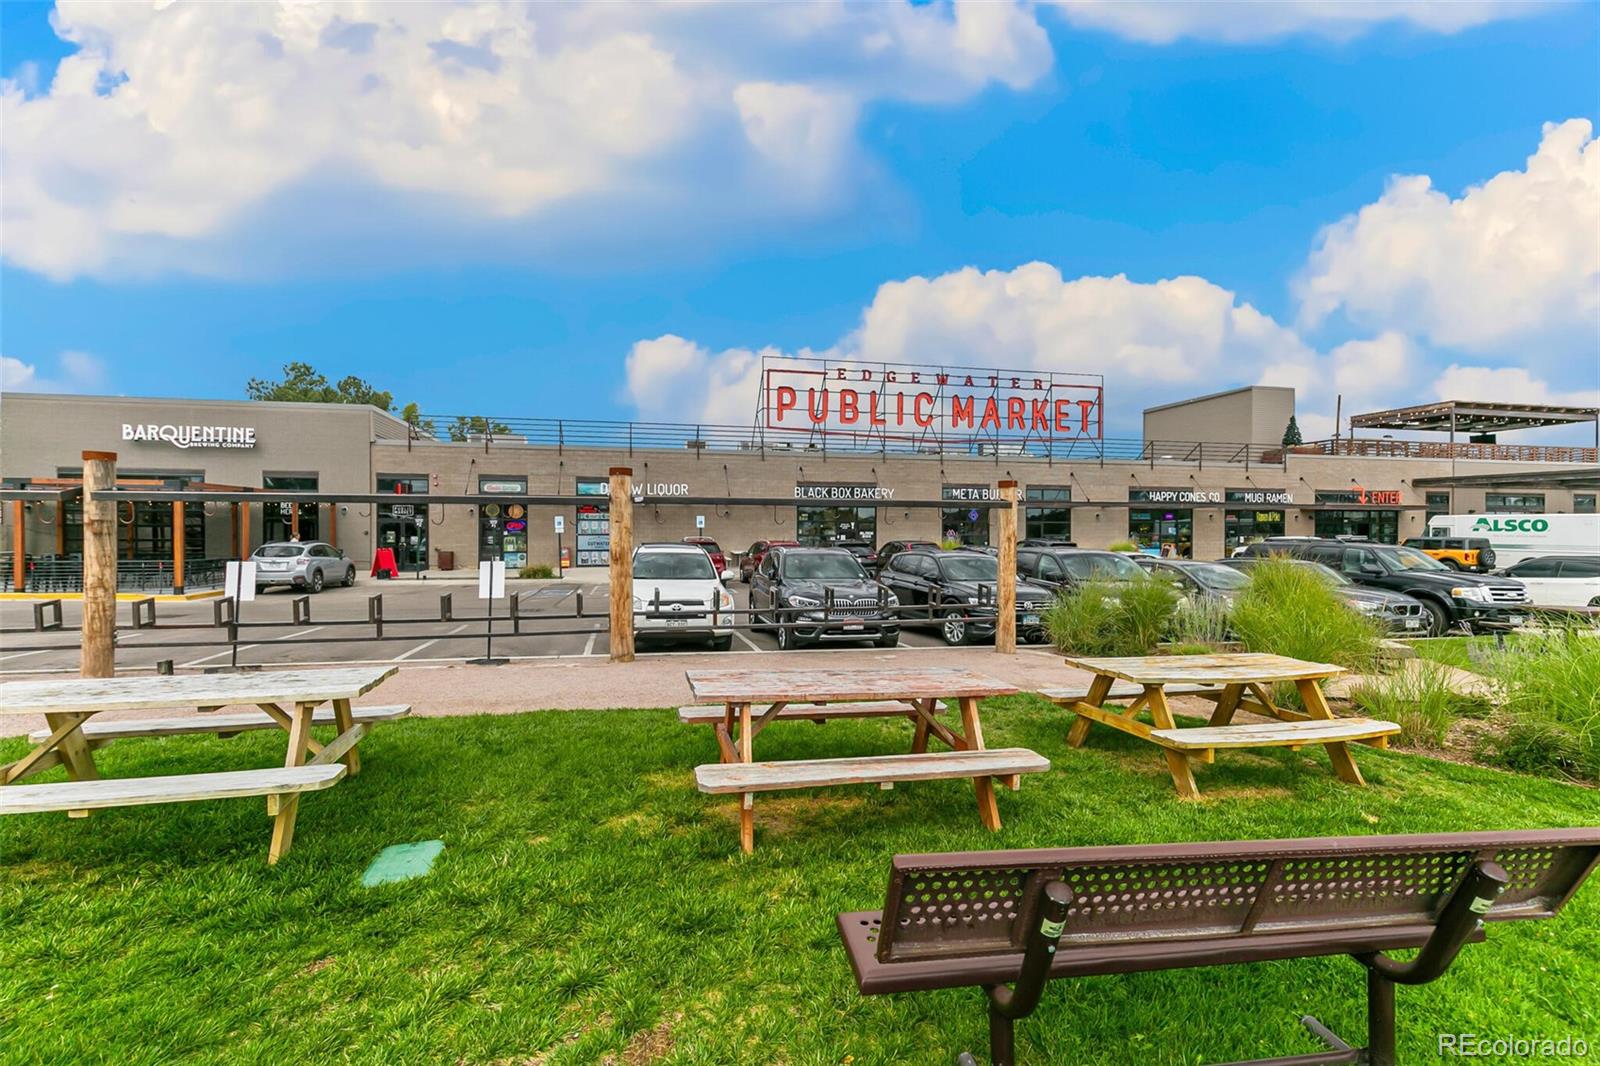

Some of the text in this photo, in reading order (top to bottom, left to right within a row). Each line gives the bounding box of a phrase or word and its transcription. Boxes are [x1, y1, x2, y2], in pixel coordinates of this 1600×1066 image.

[837, 368, 1043, 390] EDGEWATER
[777, 386, 1094, 432] PUBLIC MARKET
[122, 424, 256, 448] BARQUENTINE
[647, 483, 689, 496] LIQUOR
[794, 486, 895, 499] BLACK BOX BAKERY
[952, 488, 1025, 501] META BUR
[1149, 491, 1178, 502] HAPPY
[1179, 491, 1206, 502] CONES
[1244, 492, 1293, 504] MUGI RAMEN
[1371, 490, 1403, 505] ENTER
[1471, 517, 1549, 532] ALSCO
